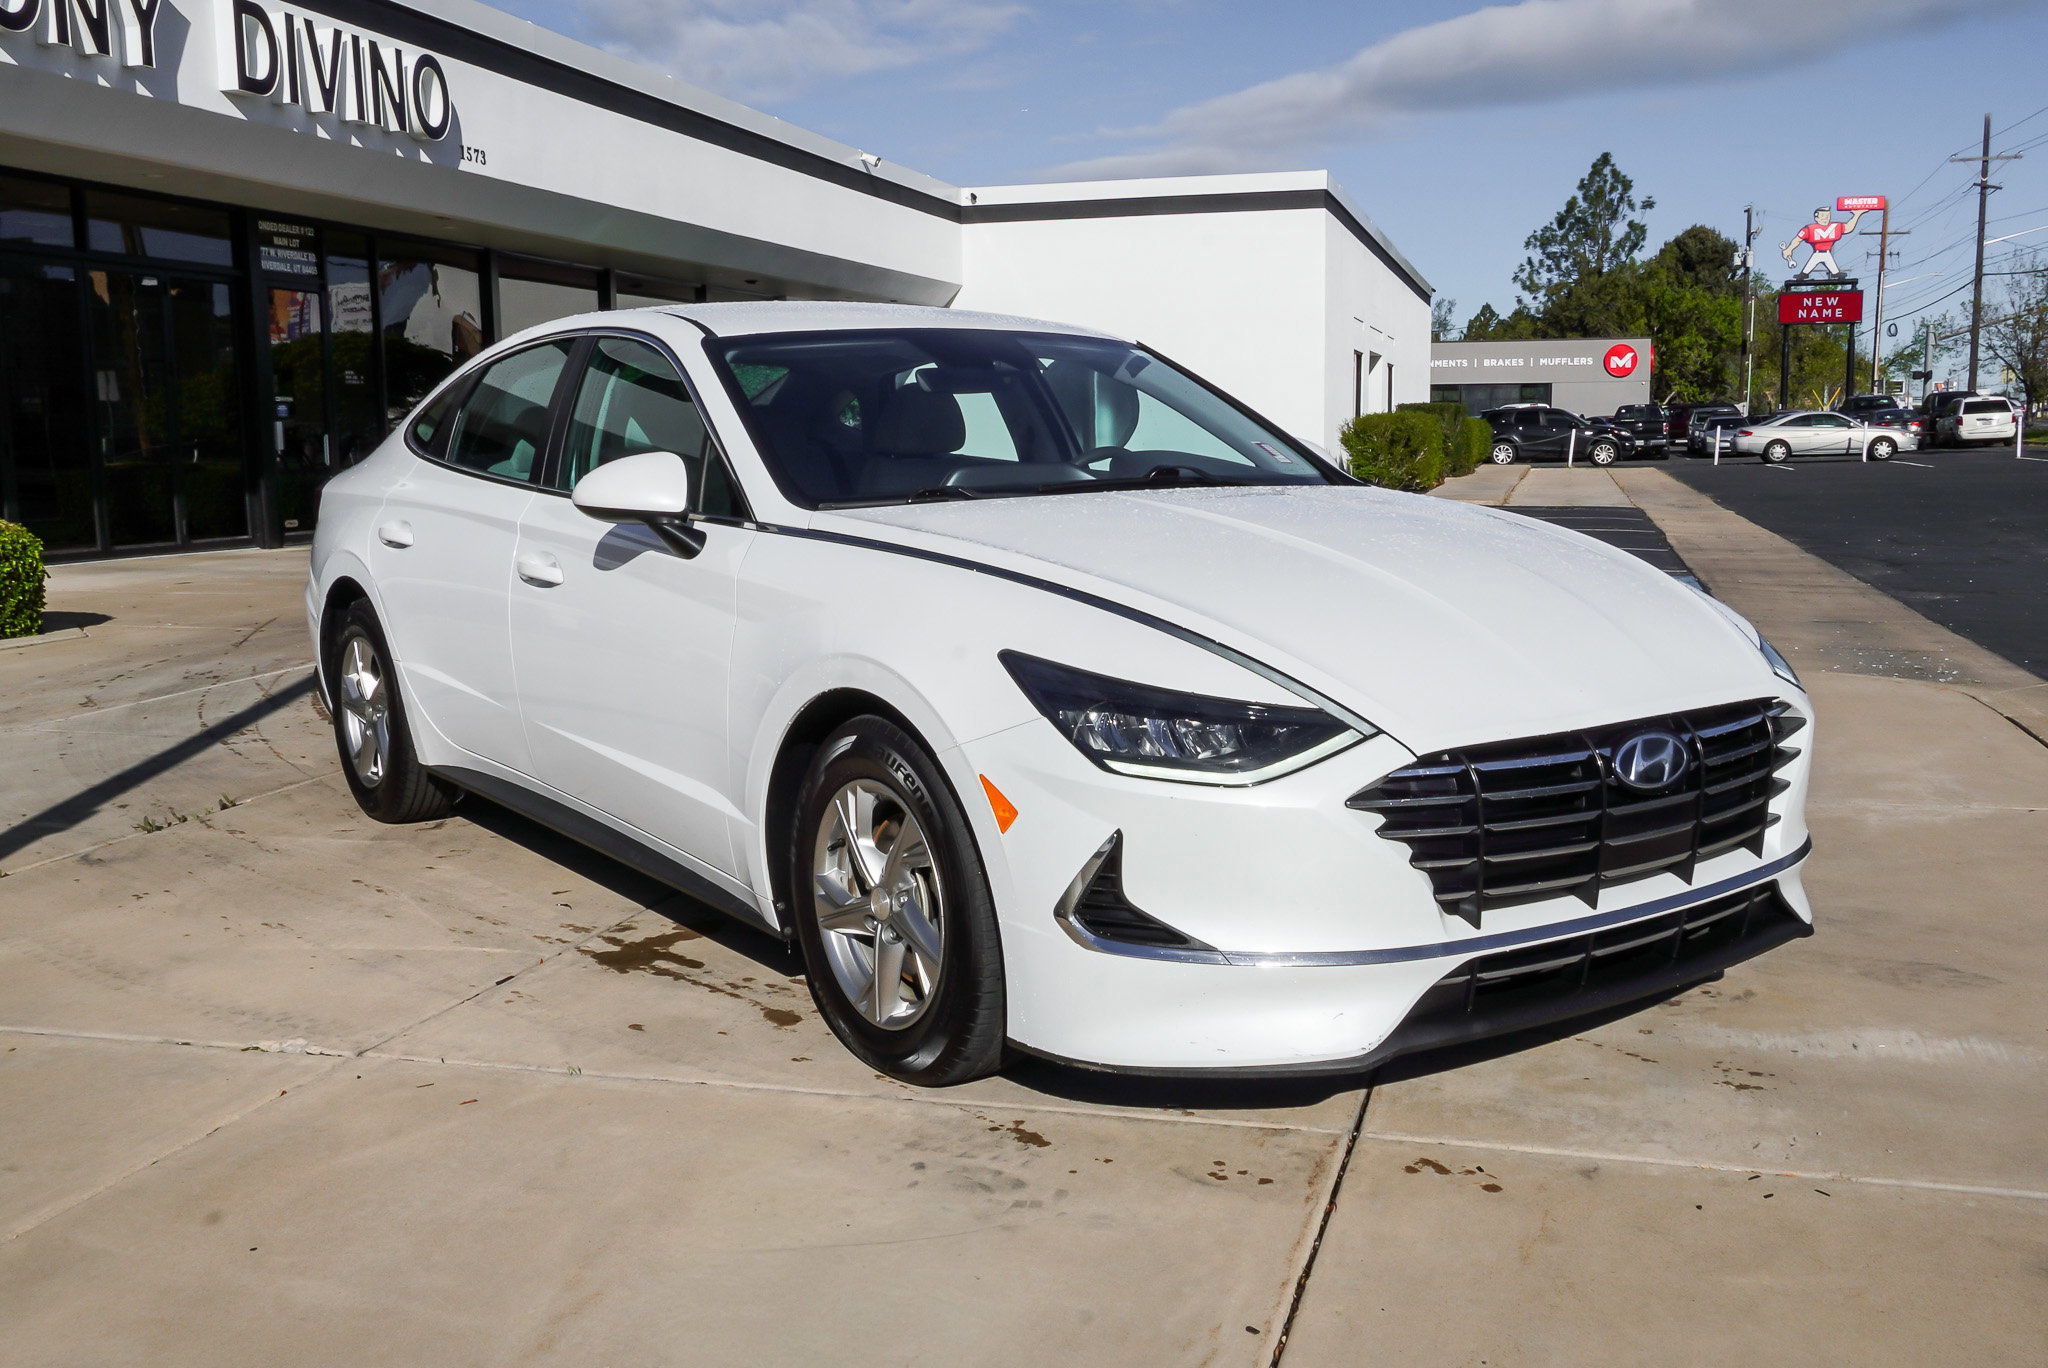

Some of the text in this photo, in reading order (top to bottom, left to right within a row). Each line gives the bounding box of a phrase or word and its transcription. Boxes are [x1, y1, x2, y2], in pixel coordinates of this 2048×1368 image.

[231, 0, 452, 141] DIVINO
[460, 144, 487, 166] 1573
[1844, 197, 1878, 205] MASTER
[289, 238, 300, 248] LOT
[277, 249, 308, 261] RIVERDALE
[1803, 296, 1839, 306] NEW
[1798, 308, 1843, 318] NAME
[1483, 358, 1524, 367] BRAKES
[1539, 357, 1594, 366] MUFFLERS
